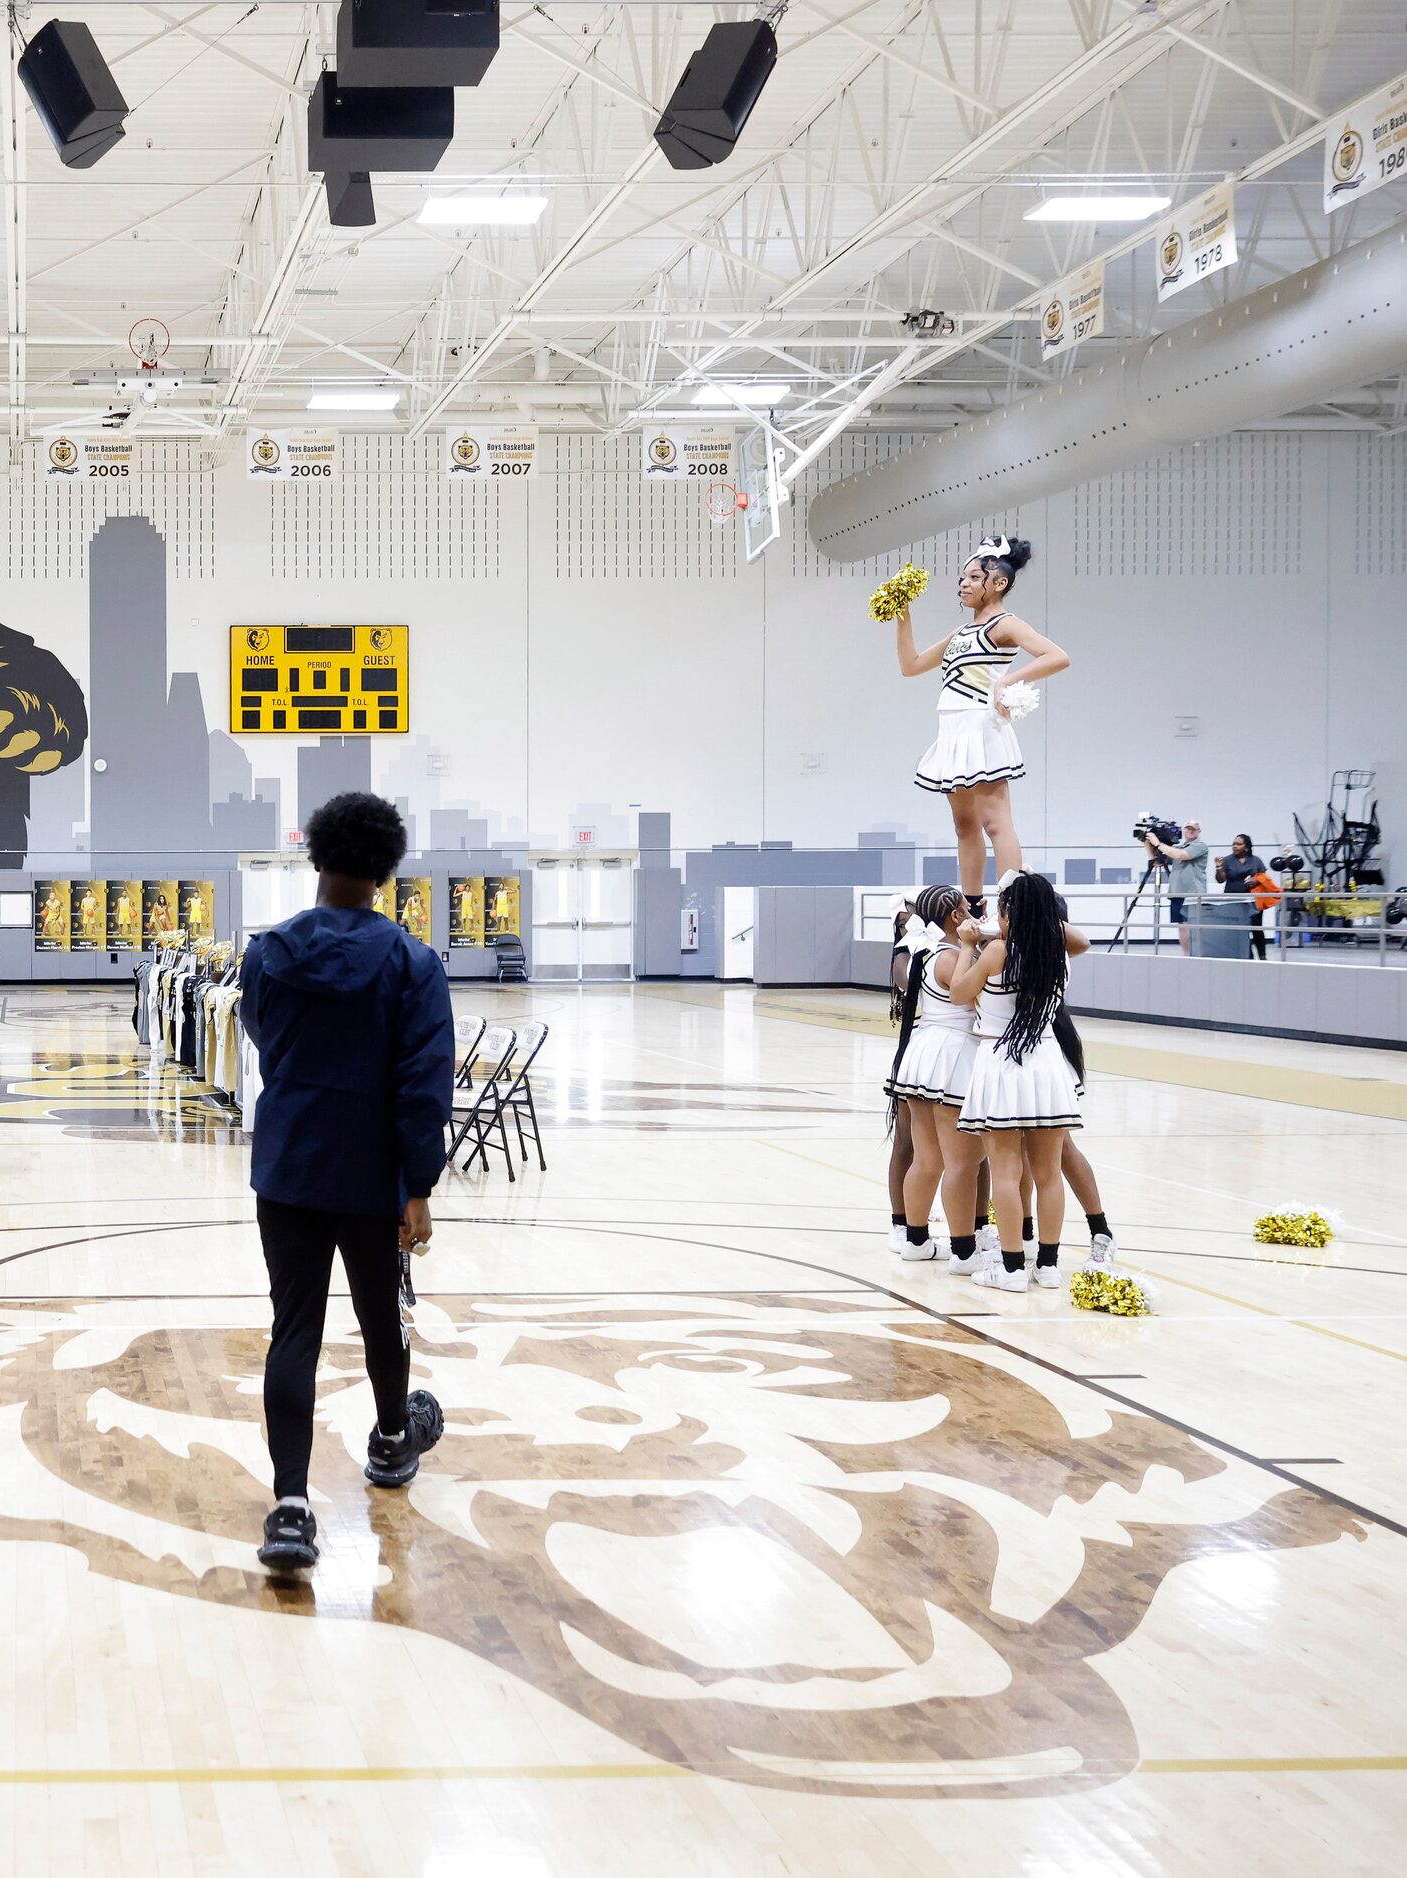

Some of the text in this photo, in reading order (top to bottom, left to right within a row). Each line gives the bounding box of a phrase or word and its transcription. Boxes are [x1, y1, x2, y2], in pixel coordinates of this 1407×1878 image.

[1379, 146, 1407, 180] 198
[1194, 244, 1223, 274] 1978
[1072, 314, 1097, 340] 1977
[85, 445, 99, 453] Boys
[287, 445, 301, 453] Boys
[700, 443, 731, 451] Basketball
[89, 465, 129, 476] 2005
[291, 465, 331, 476] 2006
[491, 463, 531, 475] 2007
[688, 464, 727, 475] 2008
[246, 655, 275, 665] HOME
[307, 661, 332, 669] PERIOD
[363, 655, 396, 666] GUEST
[288, 832, 303, 843] EXIT
[579, 832, 592, 843] EXIT
